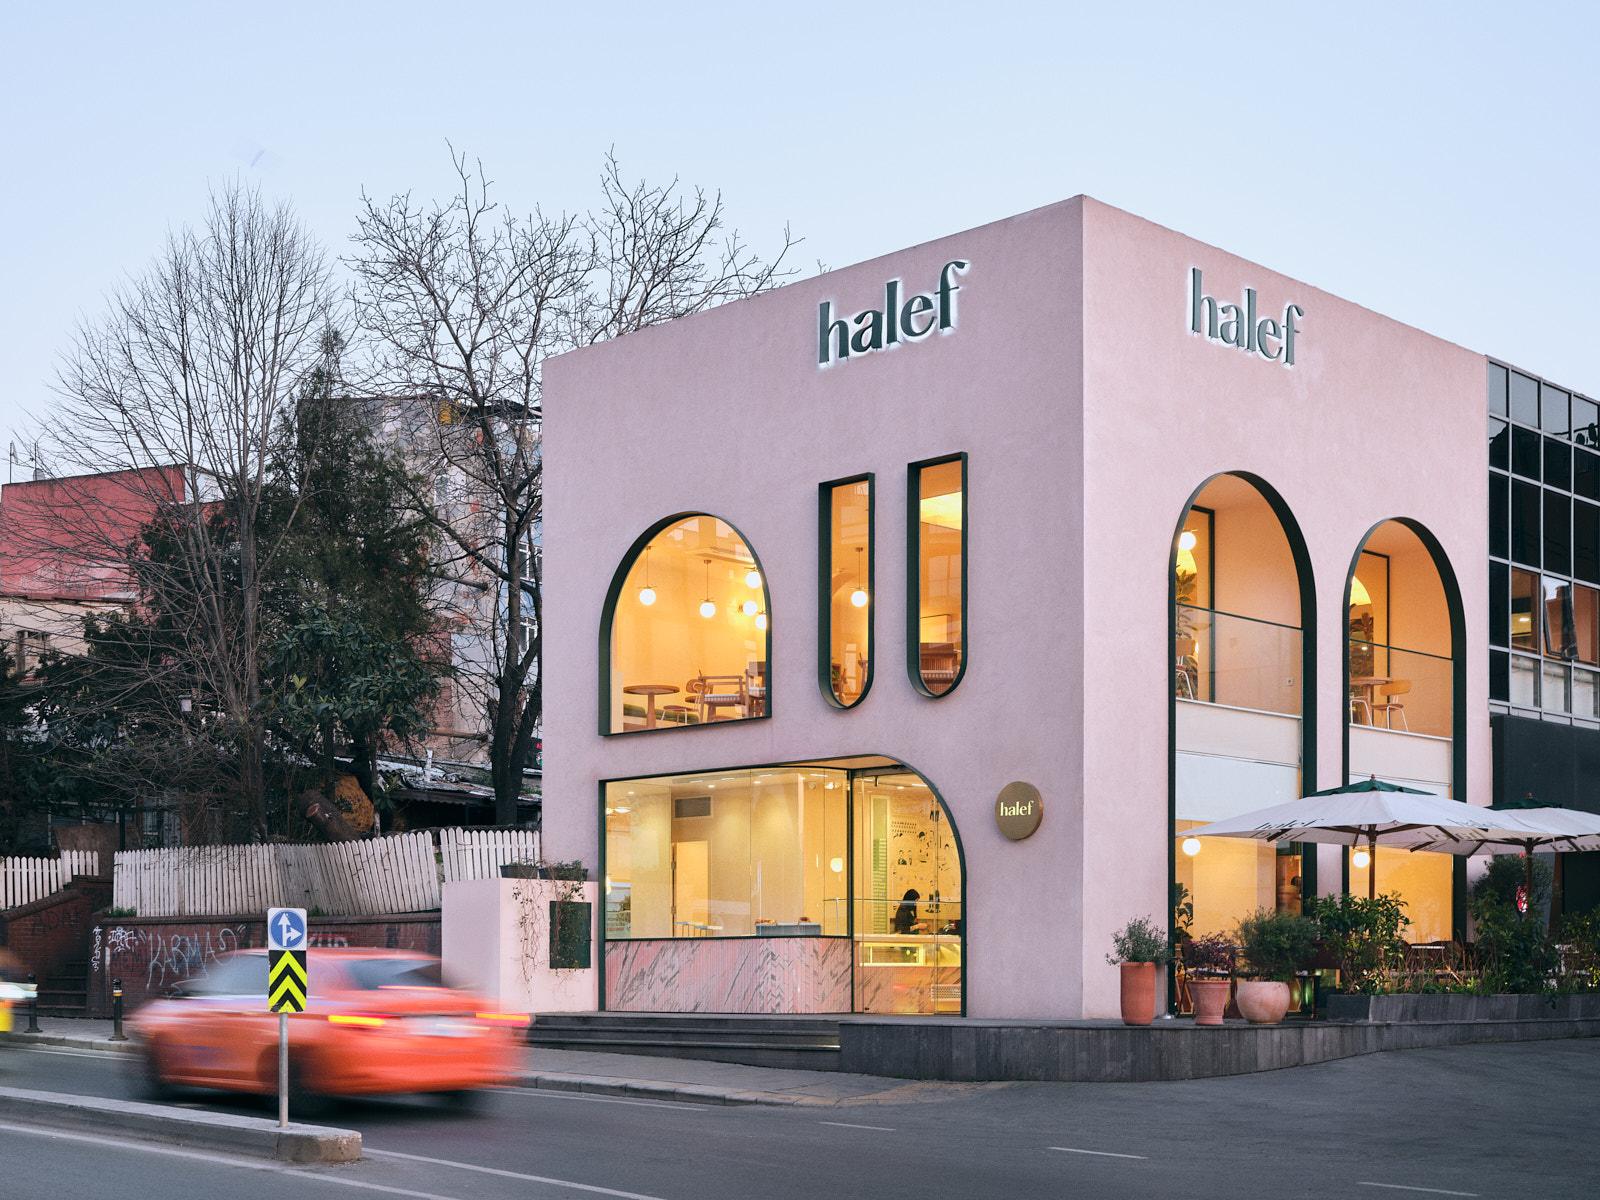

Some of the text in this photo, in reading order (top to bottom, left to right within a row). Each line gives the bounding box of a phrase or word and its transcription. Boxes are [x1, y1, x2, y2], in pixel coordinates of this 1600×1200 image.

[819, 261, 966, 363] halef
[1192, 268, 1304, 365] halef
[1000, 800, 1034, 817] halef
